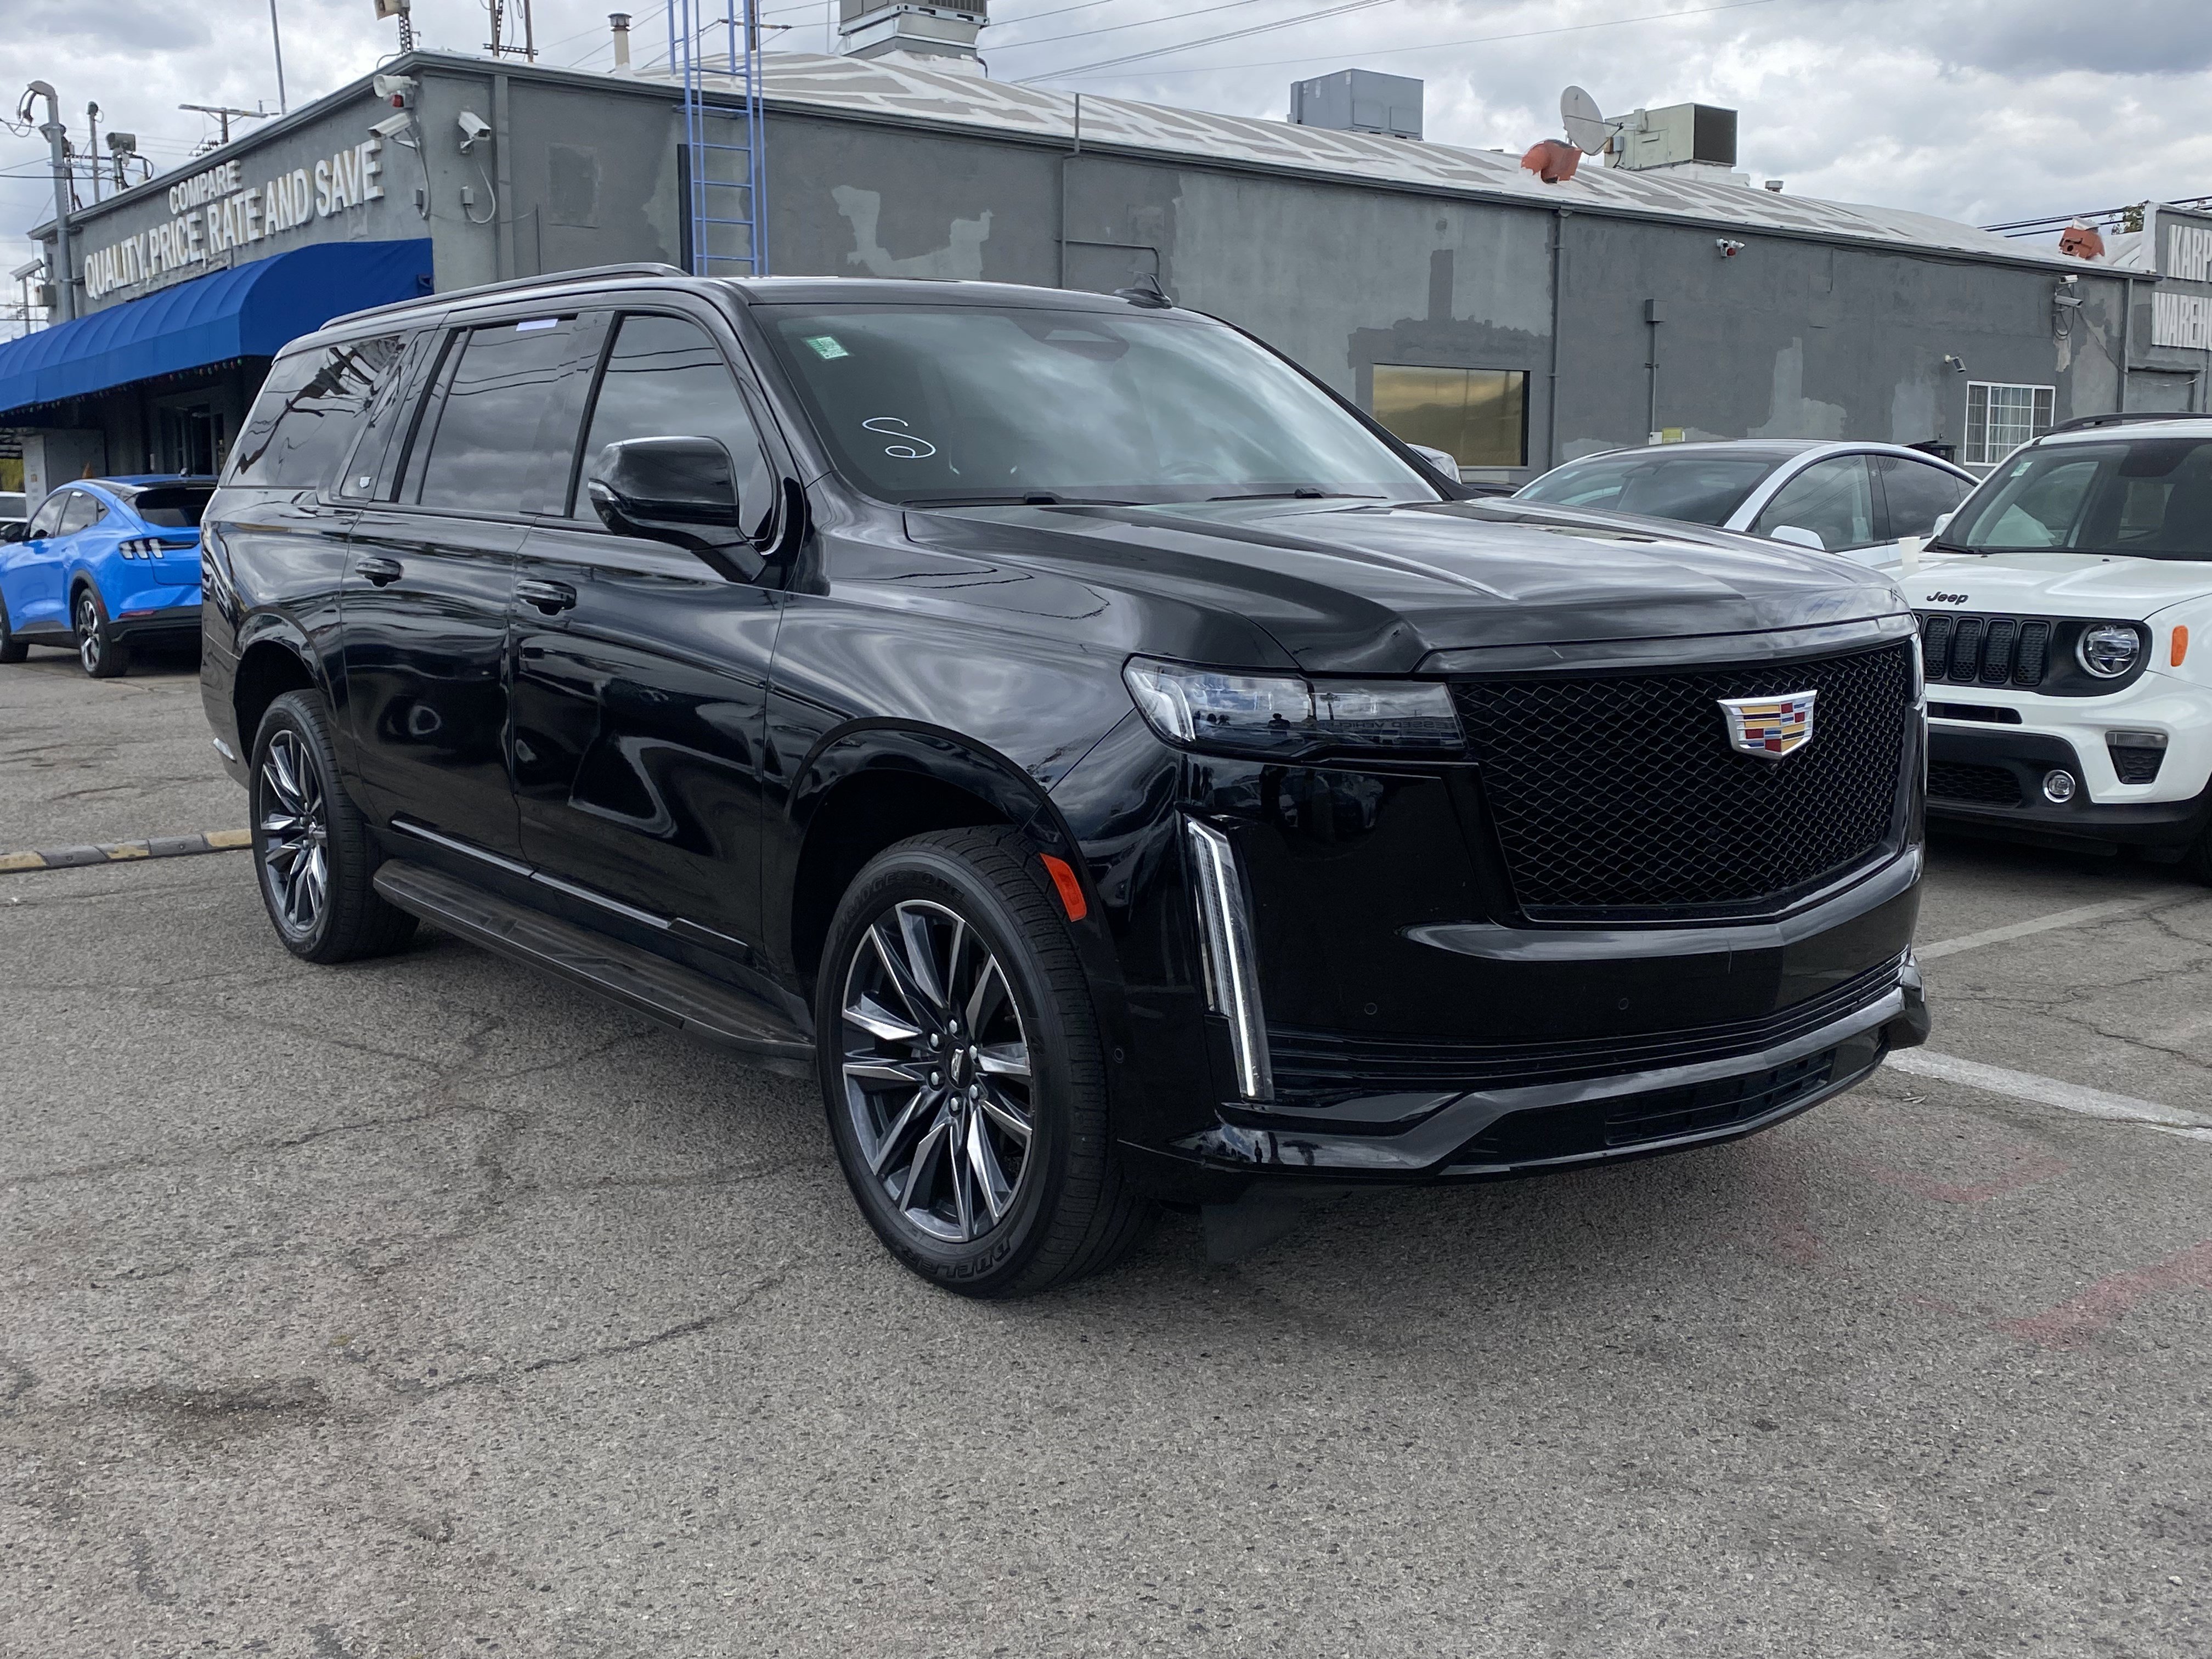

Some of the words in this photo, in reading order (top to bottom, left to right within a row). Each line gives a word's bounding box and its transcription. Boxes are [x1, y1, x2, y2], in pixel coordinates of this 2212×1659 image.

[169, 159, 242, 215] COMPARE
[84, 233, 153, 300] QUALITY,
[148, 212, 207, 275] PRICE,
[207, 187, 264, 255] RATE
[265, 168, 314, 235] AND
[315, 139, 384, 217] SAVE
[1926, 591, 1969, 605] Jeep
